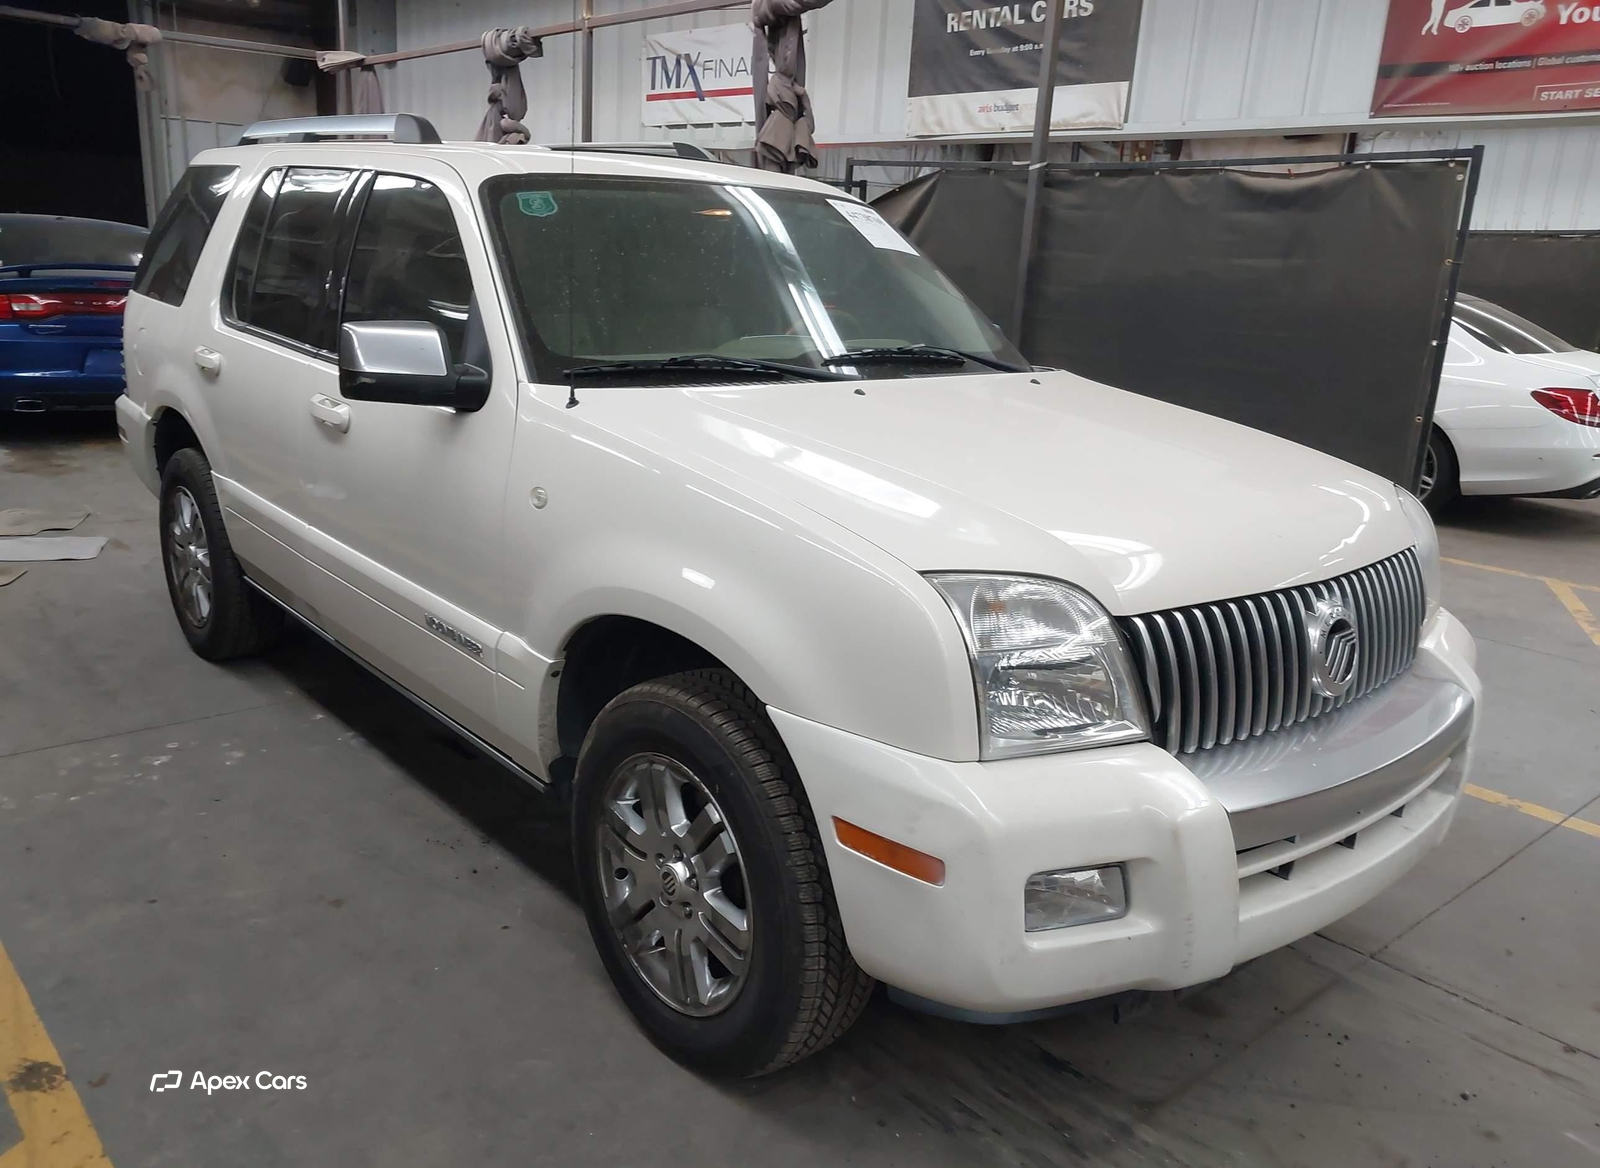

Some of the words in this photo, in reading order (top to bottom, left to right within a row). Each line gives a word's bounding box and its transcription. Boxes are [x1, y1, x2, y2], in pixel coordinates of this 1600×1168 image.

[946, 4, 1025, 33] RENTAL
[1031, 0, 1094, 23] CRS
[1464, 61, 1494, 71] auction
[1495, 60, 1531, 69] locations
[1537, 55, 1565, 66] Global
[646, 51, 705, 101] TMX
[702, 56, 776, 79] FINA
[1540, 89, 1582, 101] START
[993, 102, 1019, 113] budget
